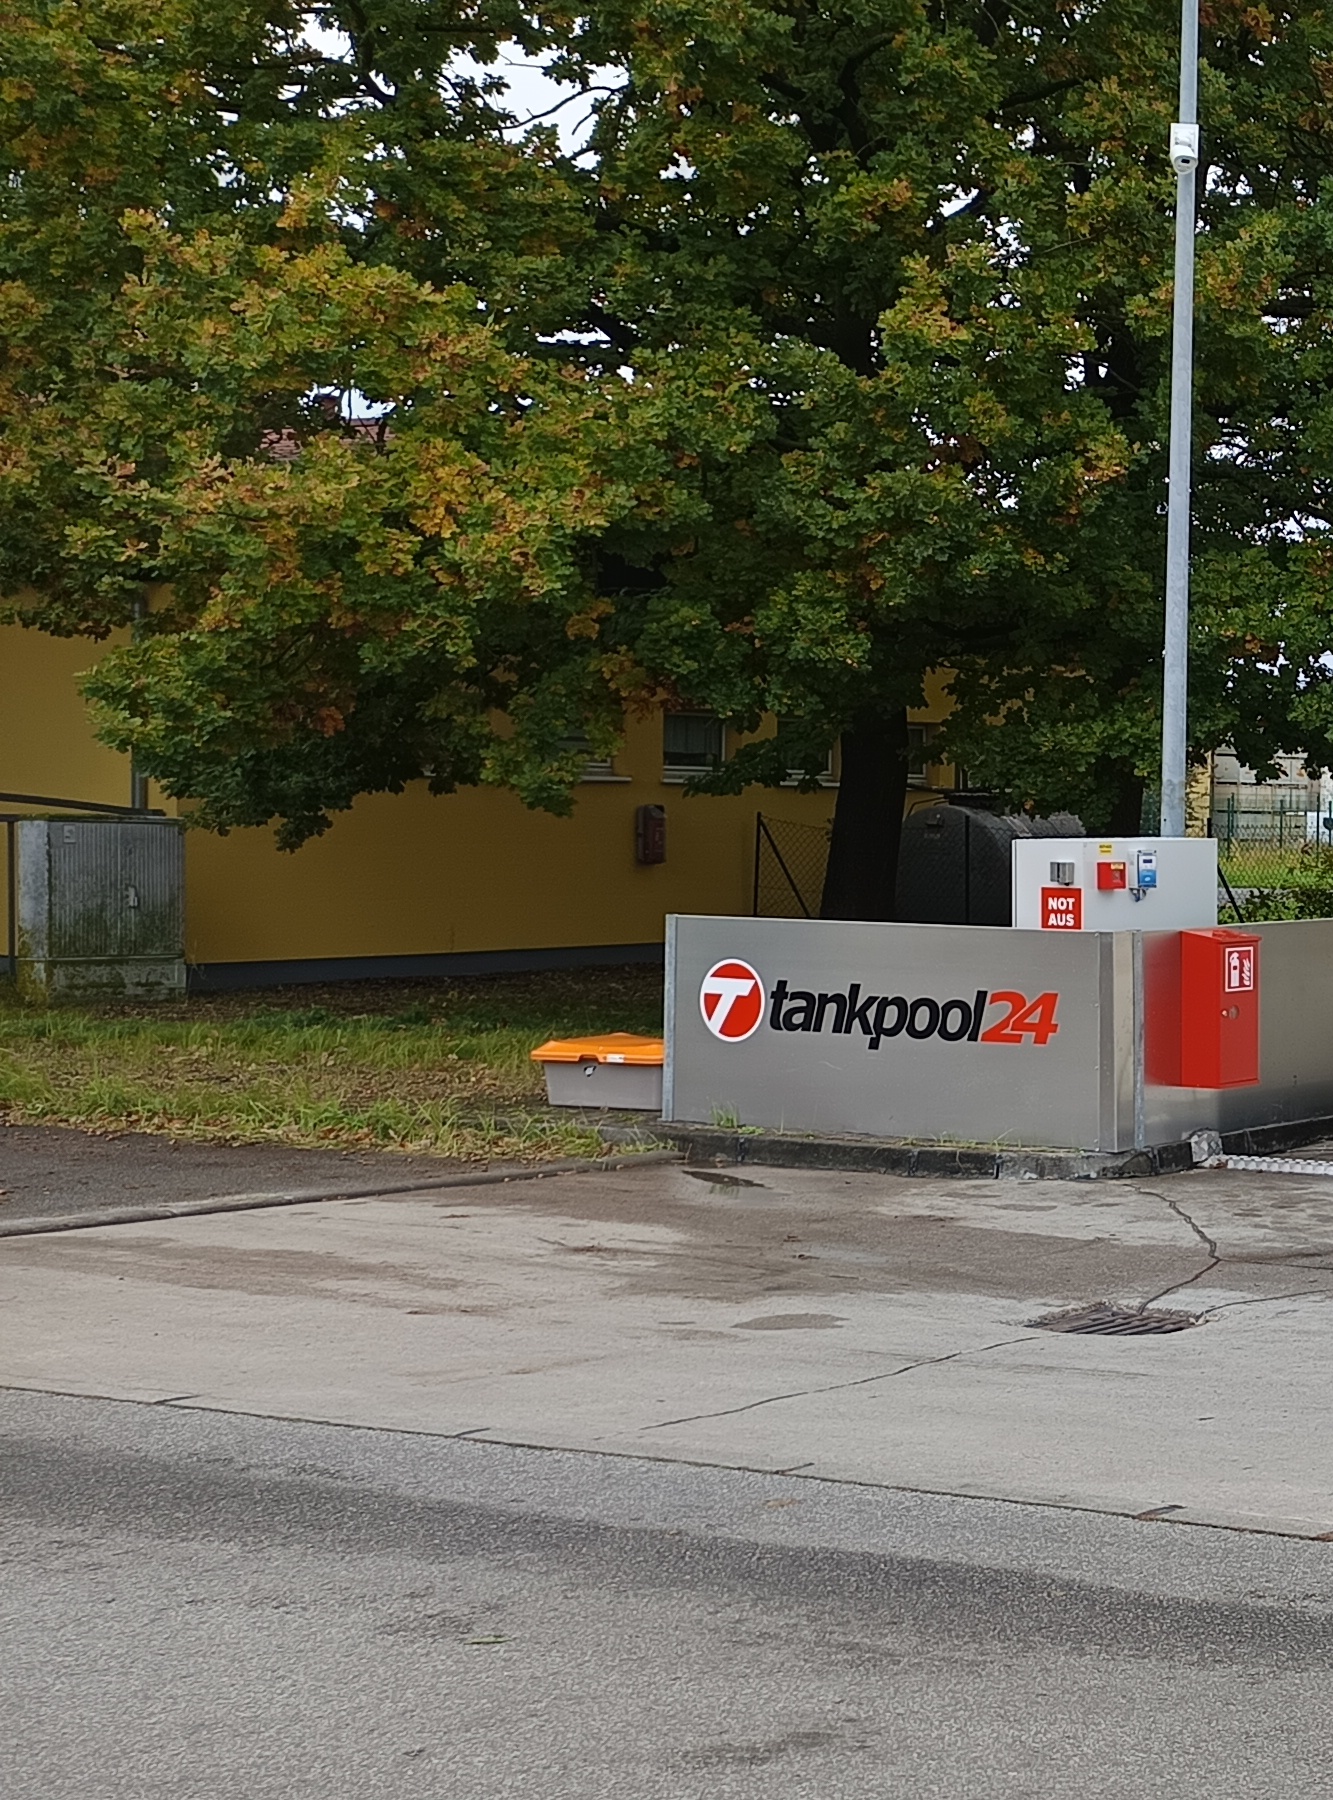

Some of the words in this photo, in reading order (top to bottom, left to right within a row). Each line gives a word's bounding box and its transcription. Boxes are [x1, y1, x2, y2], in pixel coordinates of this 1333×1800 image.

[1047, 897, 1075, 911] NOT
[1047, 912, 1075, 927] AUS
[769, 979, 1060, 1051] tankpool24
